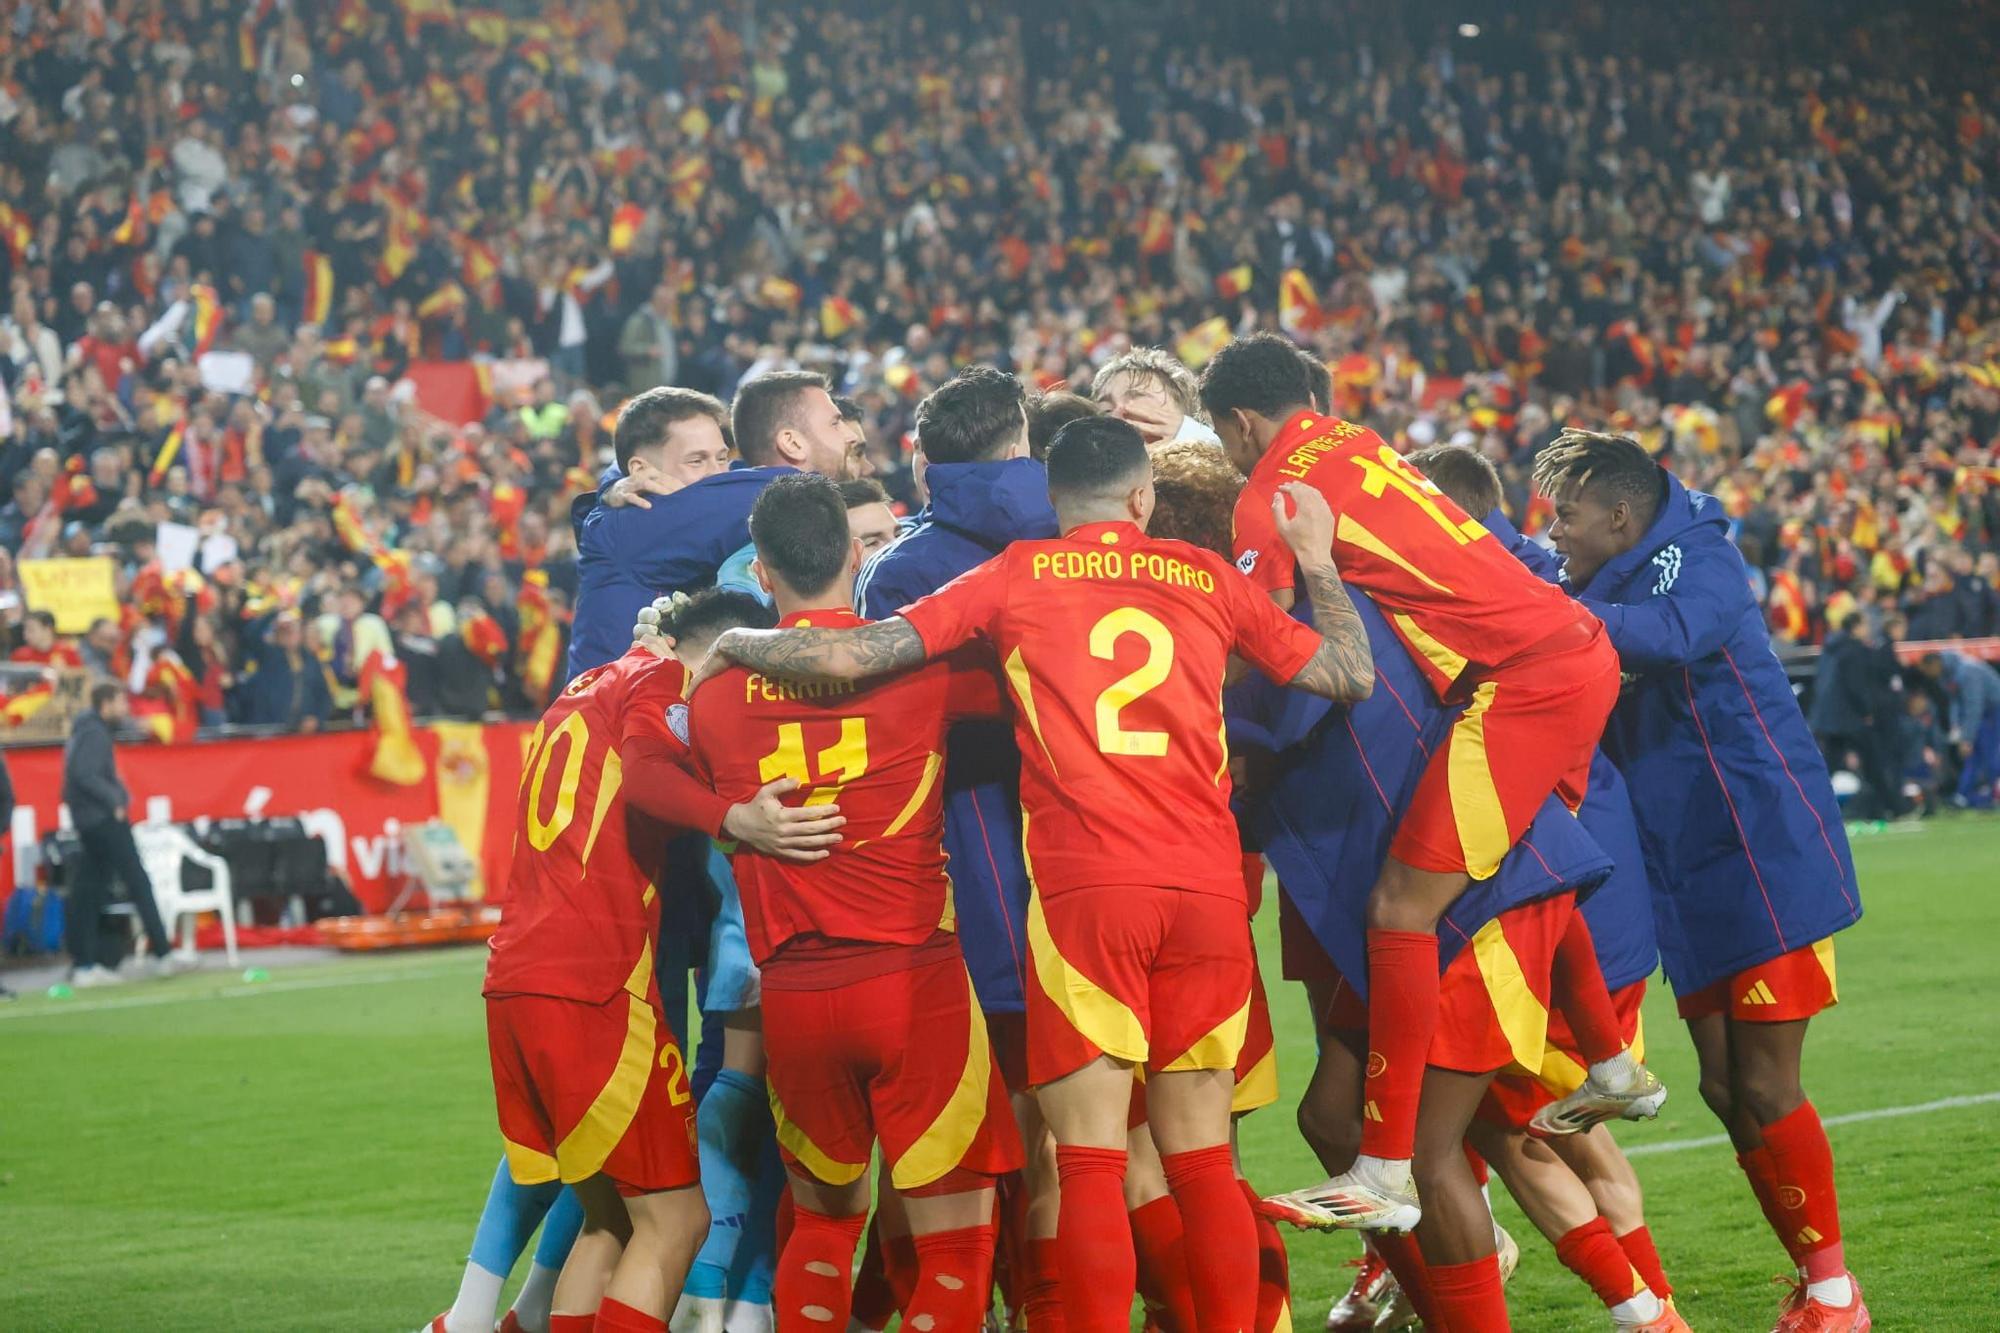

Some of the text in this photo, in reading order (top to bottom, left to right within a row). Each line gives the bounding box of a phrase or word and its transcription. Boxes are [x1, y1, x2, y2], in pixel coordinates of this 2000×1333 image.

[1032, 551, 1215, 594] PEDRO PORRO
[1088, 606, 1175, 757] 2
[758, 716, 868, 820] 11
